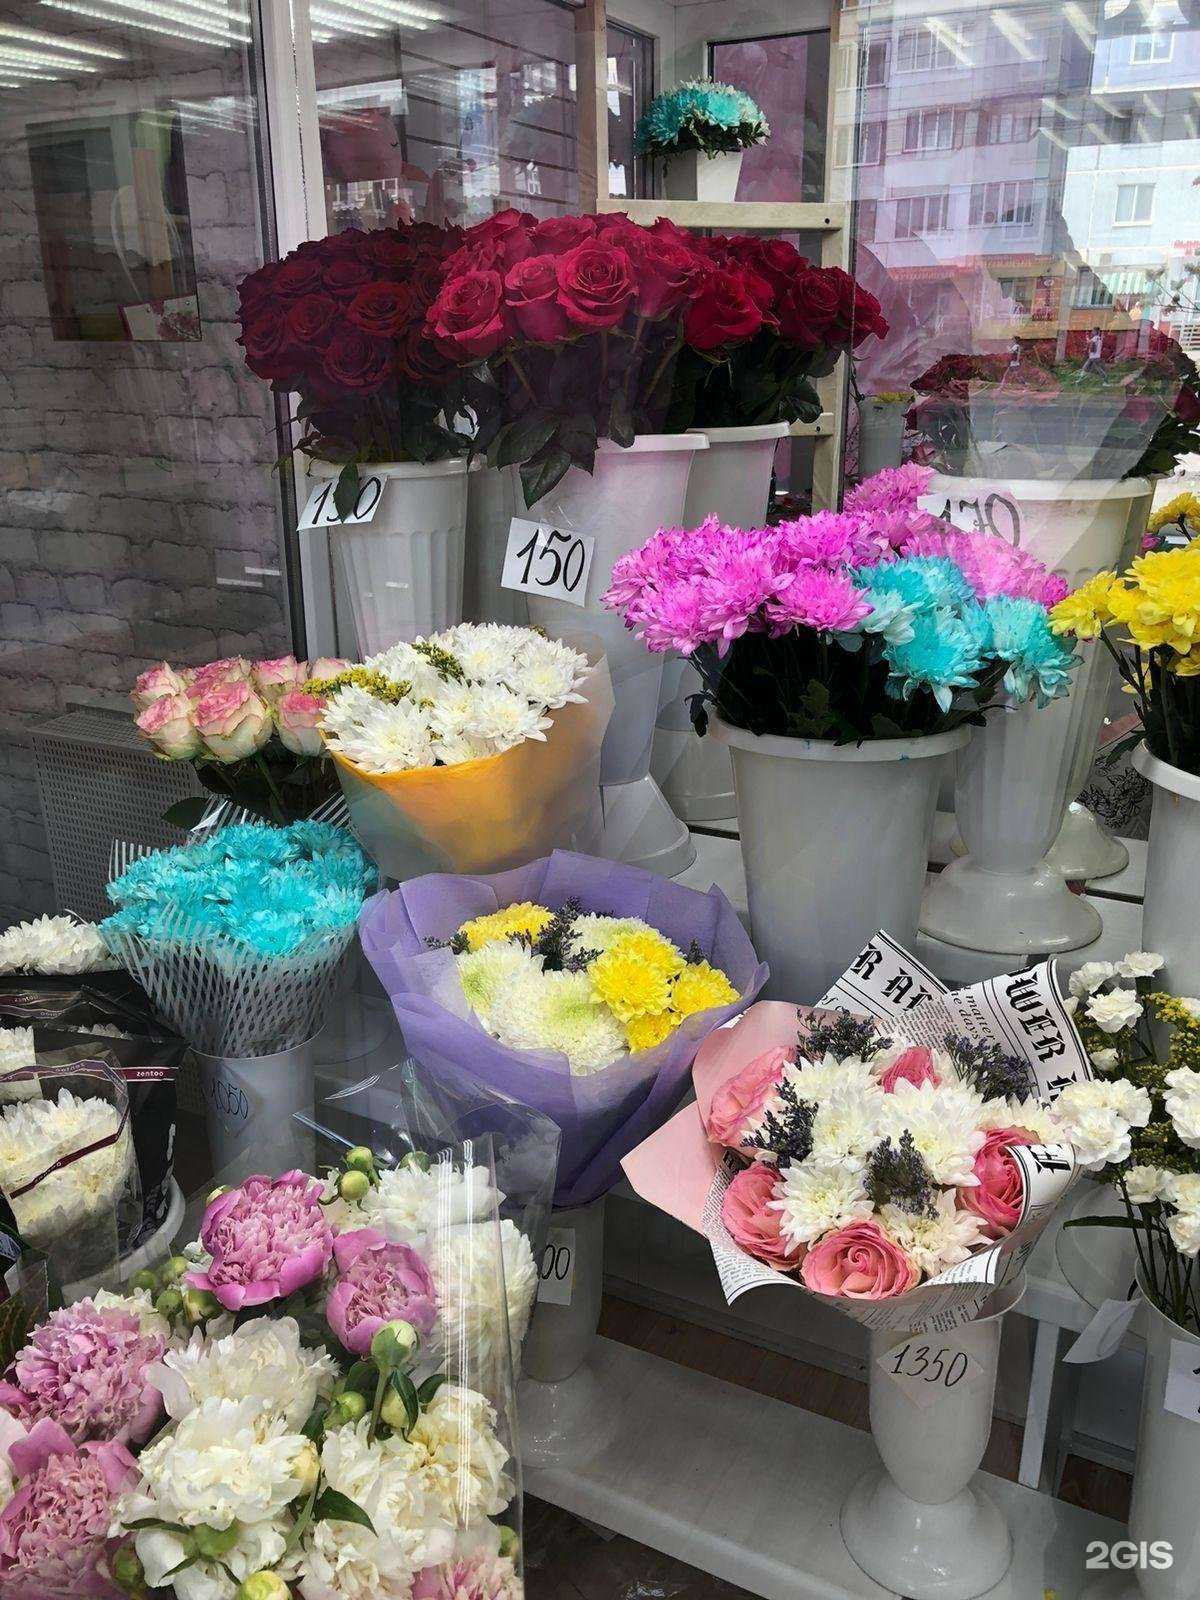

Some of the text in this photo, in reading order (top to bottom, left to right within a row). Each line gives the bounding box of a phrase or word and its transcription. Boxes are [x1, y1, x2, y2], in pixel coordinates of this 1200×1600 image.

[312, 477, 381, 524] 10
[517, 528, 585, 592] 150
[1006, 966, 1066, 1063] WER
[136, 1070, 164, 1078] zentoo
[890, 1344, 968, 1387] 1350
